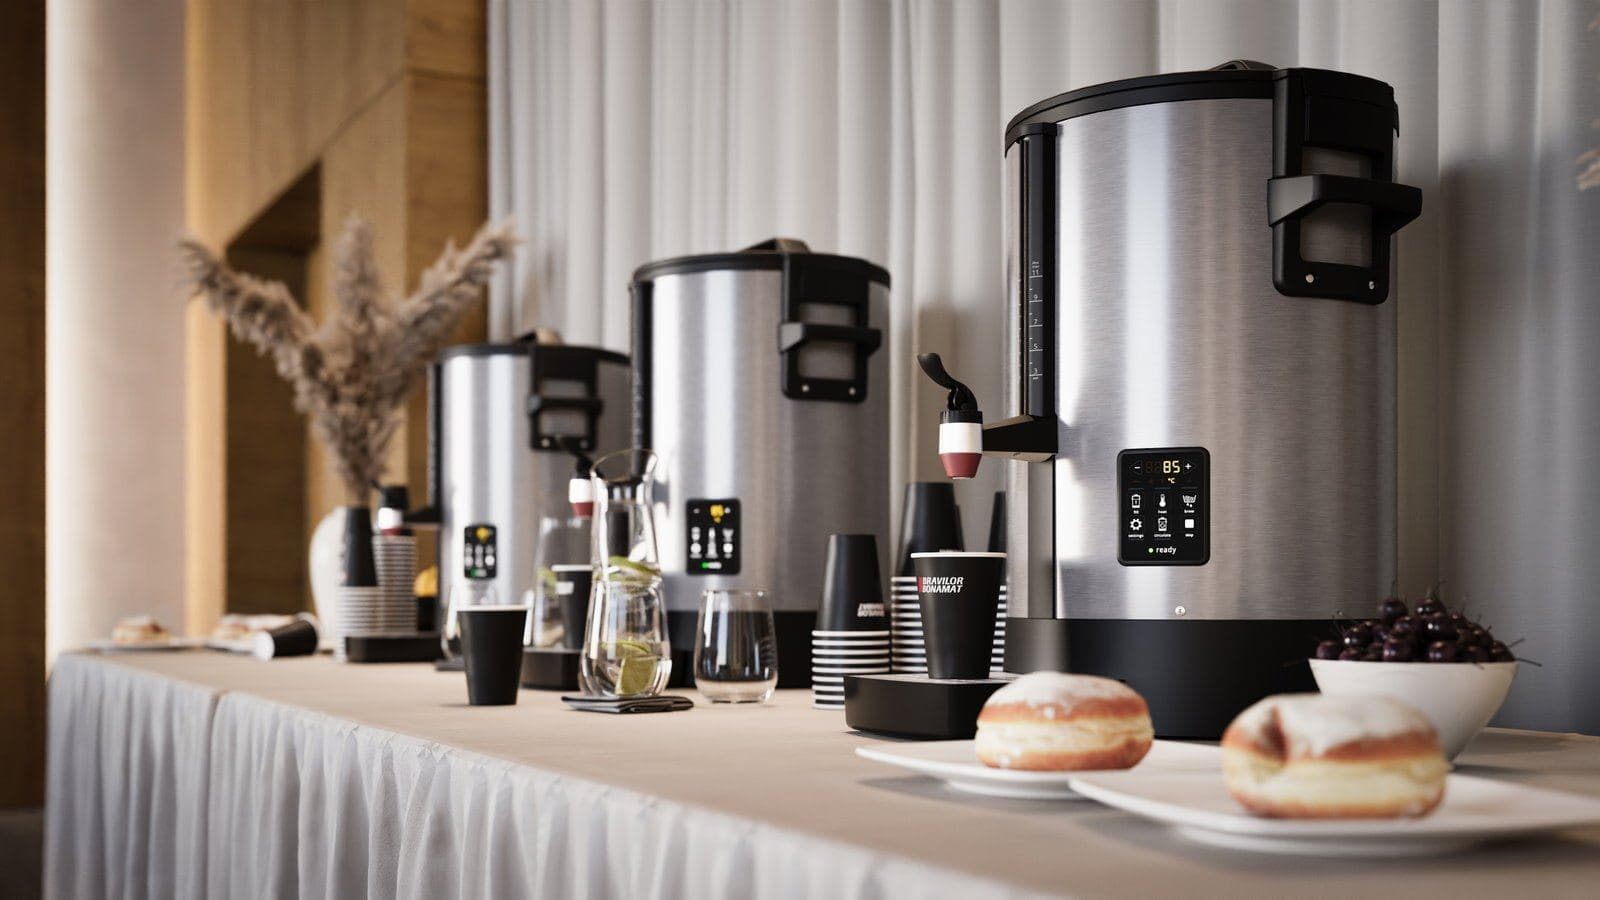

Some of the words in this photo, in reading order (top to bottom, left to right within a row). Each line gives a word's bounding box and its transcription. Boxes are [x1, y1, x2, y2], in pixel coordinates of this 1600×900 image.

[1162, 460, 1181, 474] 85
[1155, 546, 1177, 555] ready
[922, 576, 964, 584] BRAVILOR
[922, 585, 963, 593] BONAMAT
